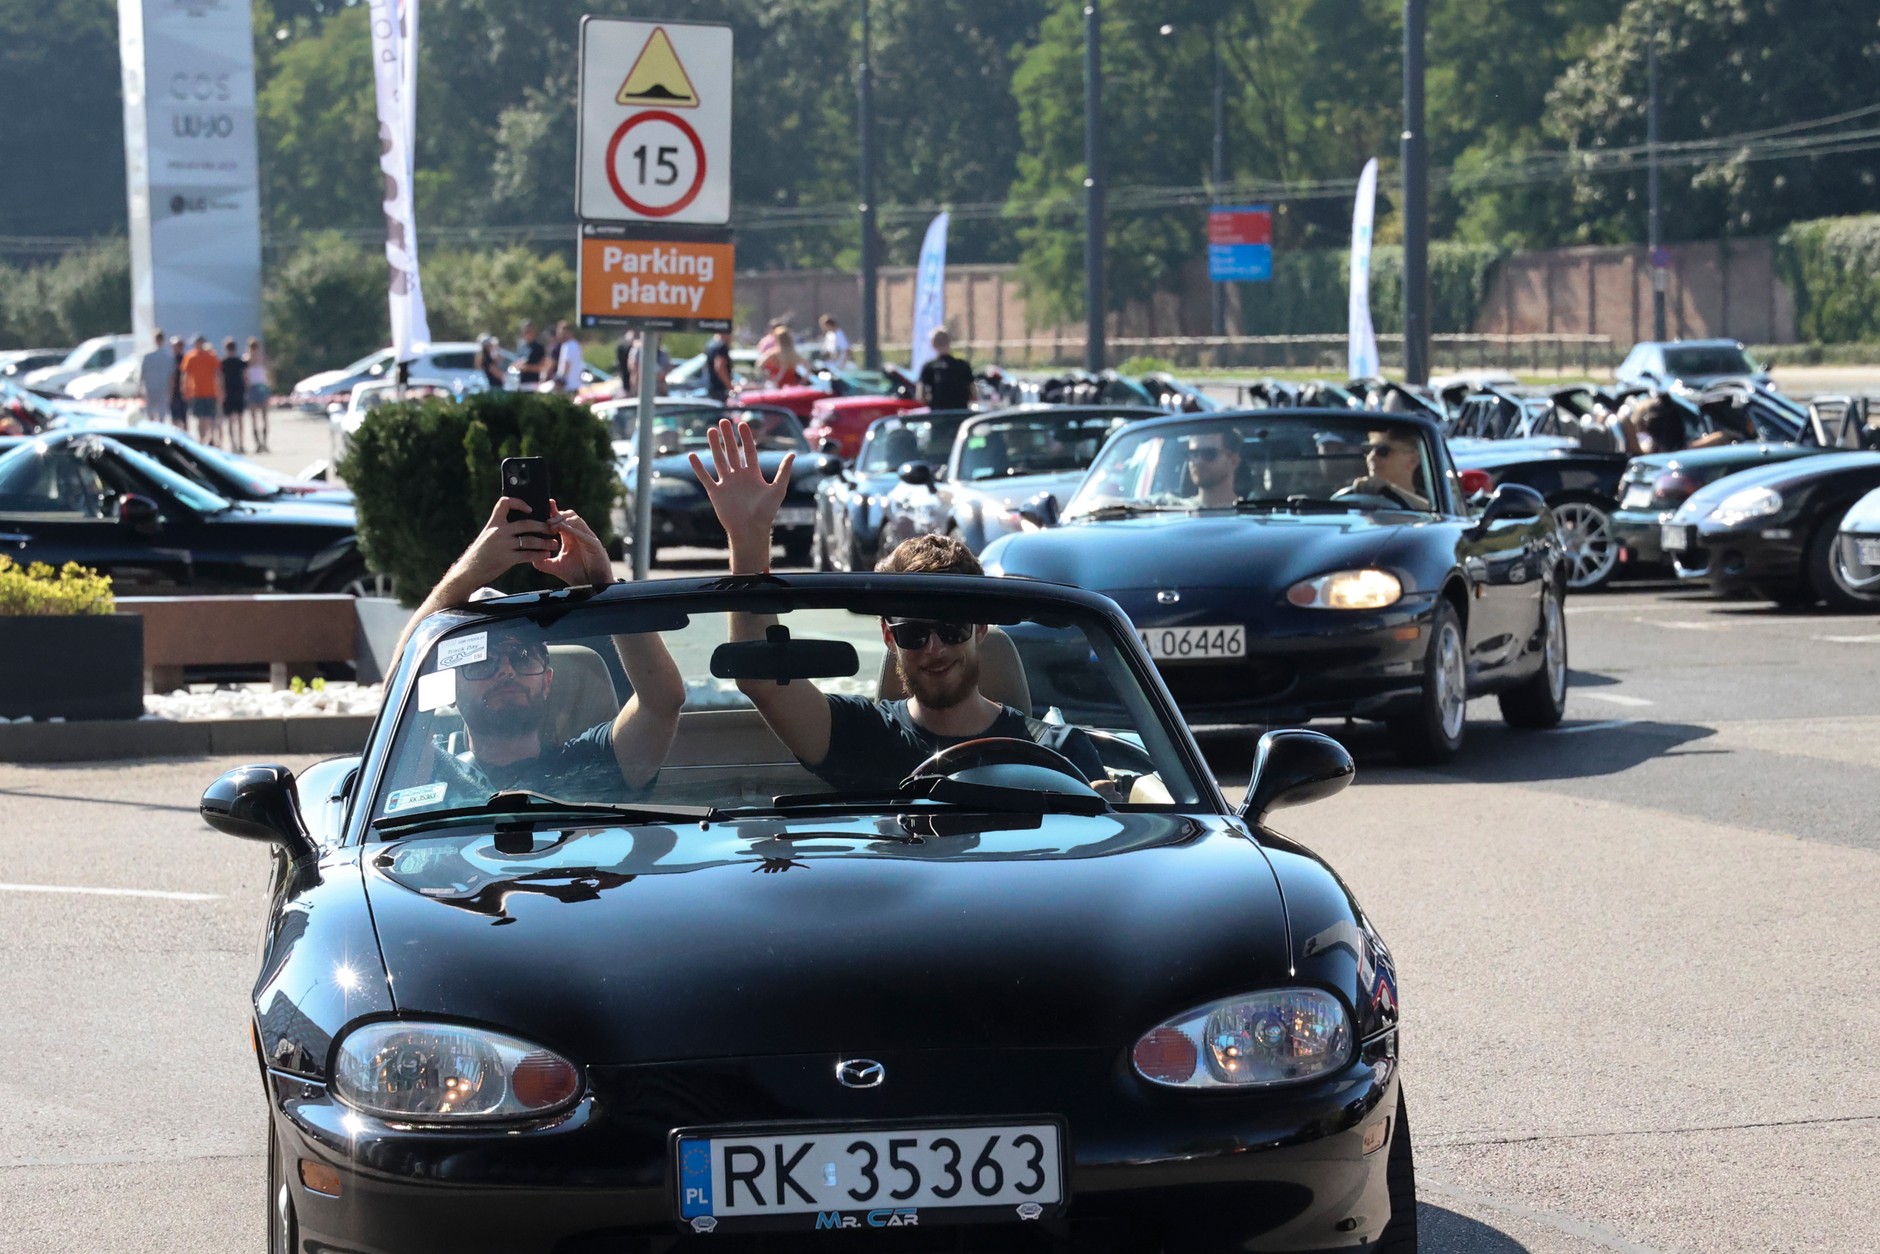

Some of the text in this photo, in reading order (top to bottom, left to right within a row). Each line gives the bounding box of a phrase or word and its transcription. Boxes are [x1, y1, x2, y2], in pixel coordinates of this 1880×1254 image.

[171, 72, 230, 100] COS
[634, 145, 679, 185] 15
[603, 246, 714, 282] Parking
[612, 277, 705, 312] płatny
[1161, 629, 1241, 655] 06446
[723, 1133, 1046, 1207] RK 35363
[686, 1188, 709, 1205] PL
